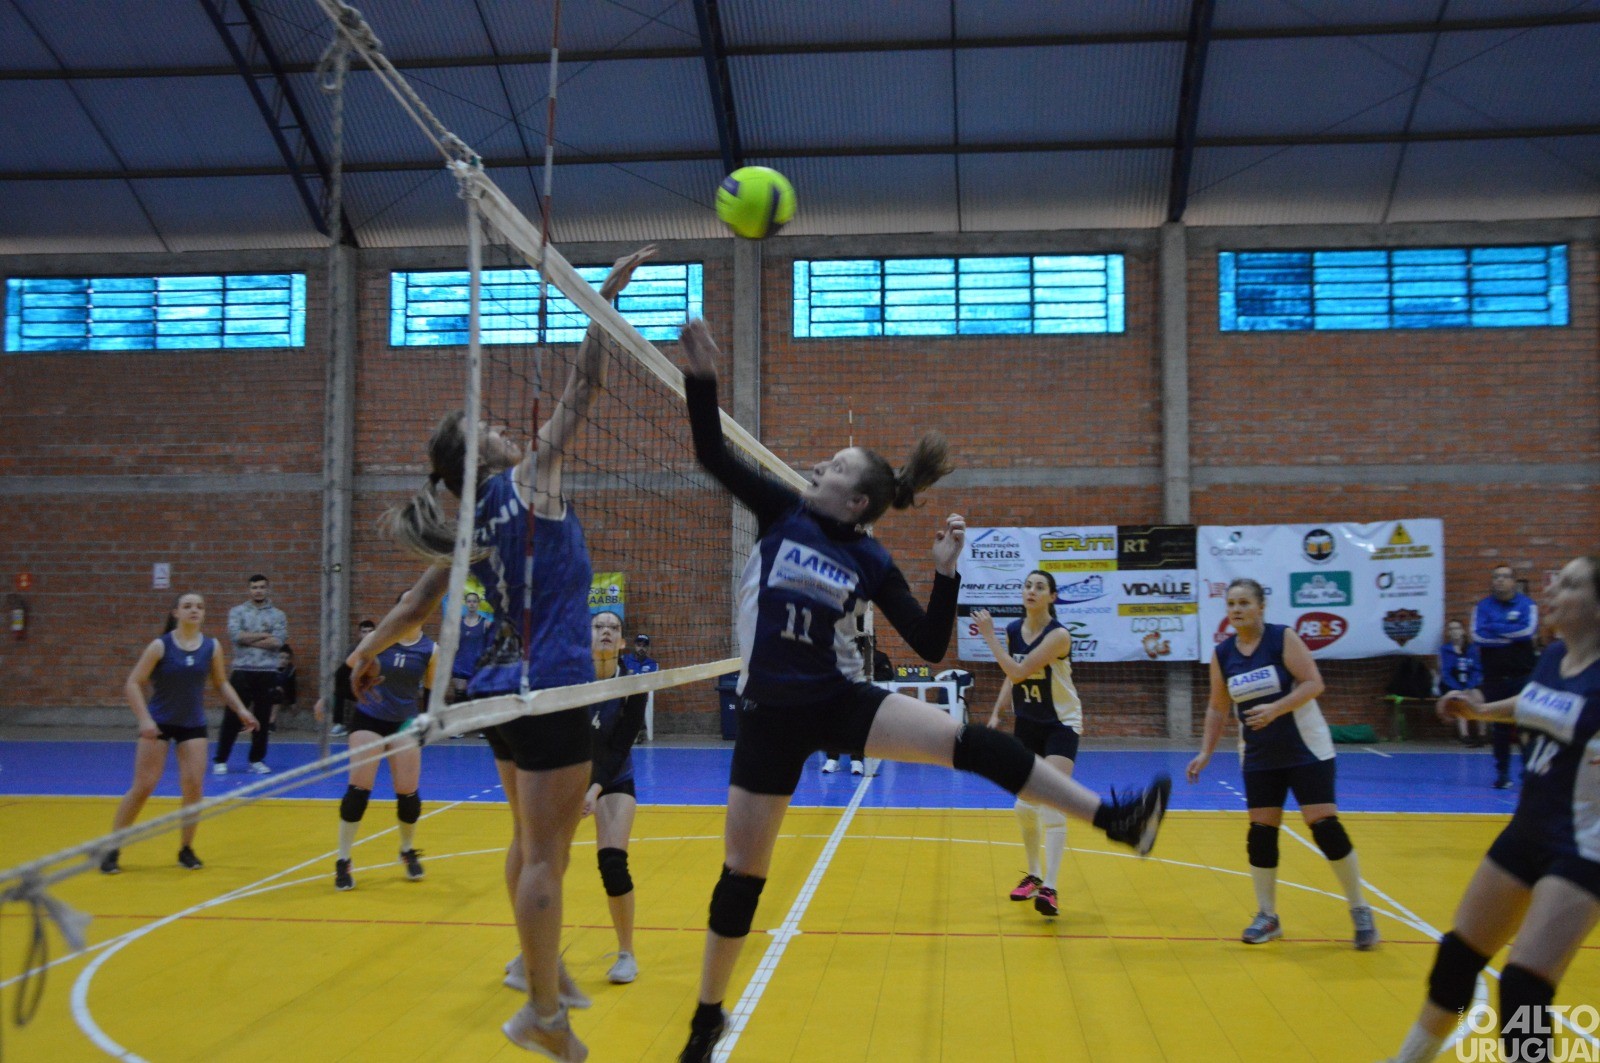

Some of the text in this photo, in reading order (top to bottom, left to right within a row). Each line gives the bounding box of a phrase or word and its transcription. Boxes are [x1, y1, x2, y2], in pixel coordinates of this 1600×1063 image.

[970, 542, 1020, 550] Construções
[971, 548, 1020, 558] Freitas
[1122, 539, 1149, 553] RT
[784, 546, 851, 586] AABB
[1122, 582, 1191, 596] VIDALLE
[780, 602, 814, 645] 11
[393, 653, 406, 668] 11
[896, 667, 907, 677] 16
[918, 667, 929, 677] 21
[1230, 669, 1271, 687] AABB
[1021, 684, 1042, 703] 14
[591, 710, 602, 730] 4
